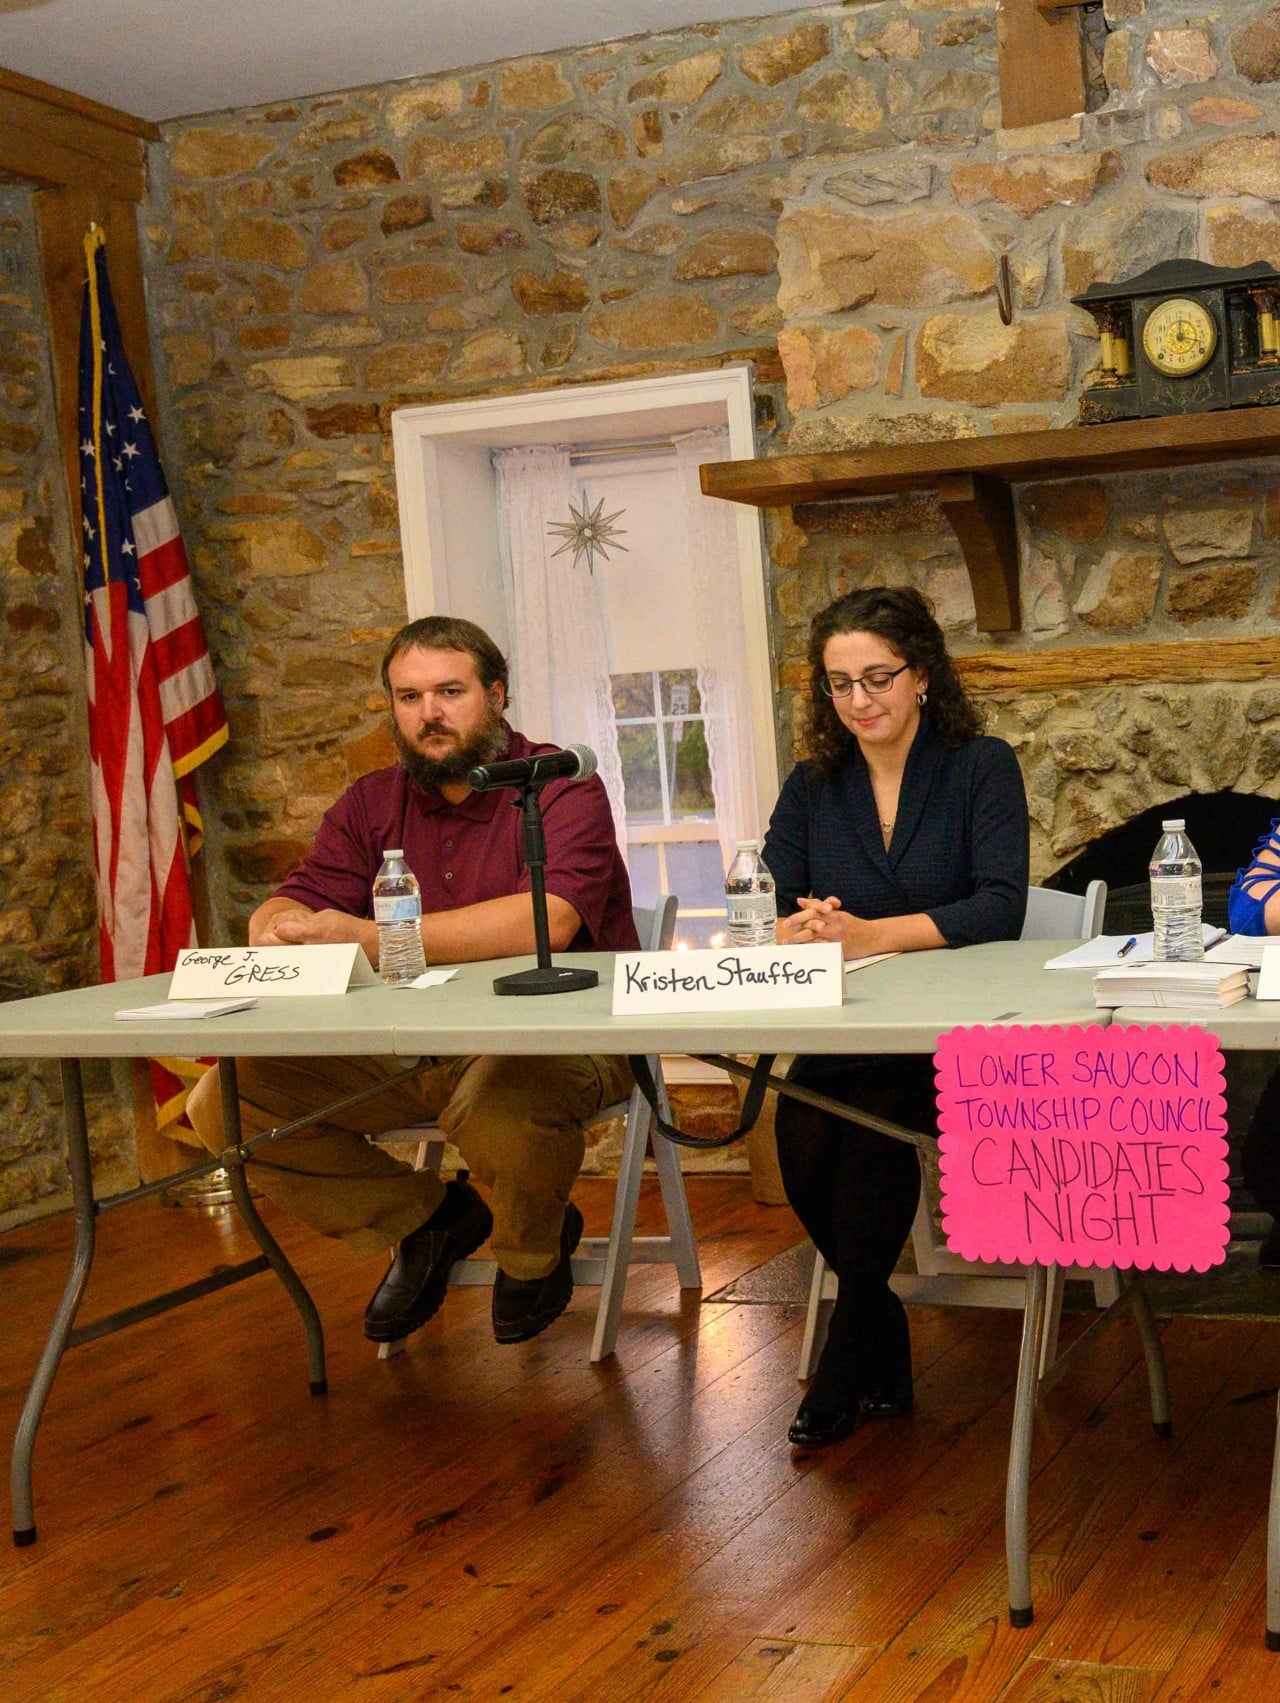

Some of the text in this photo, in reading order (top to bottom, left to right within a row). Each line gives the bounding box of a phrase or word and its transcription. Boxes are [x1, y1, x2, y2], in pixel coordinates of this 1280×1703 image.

[181, 952, 233, 968] George
[224, 965, 301, 986] GRESS
[625, 957, 827, 994] Kristen Stauffer
[956, 1050, 1199, 1088] LOWER SAUCON
[954, 1096, 1225, 1136] TOWNSHIP COUNCIL
[971, 1136, 1205, 1195] CANDIDATES
[1023, 1191, 1175, 1246] NIGHT
